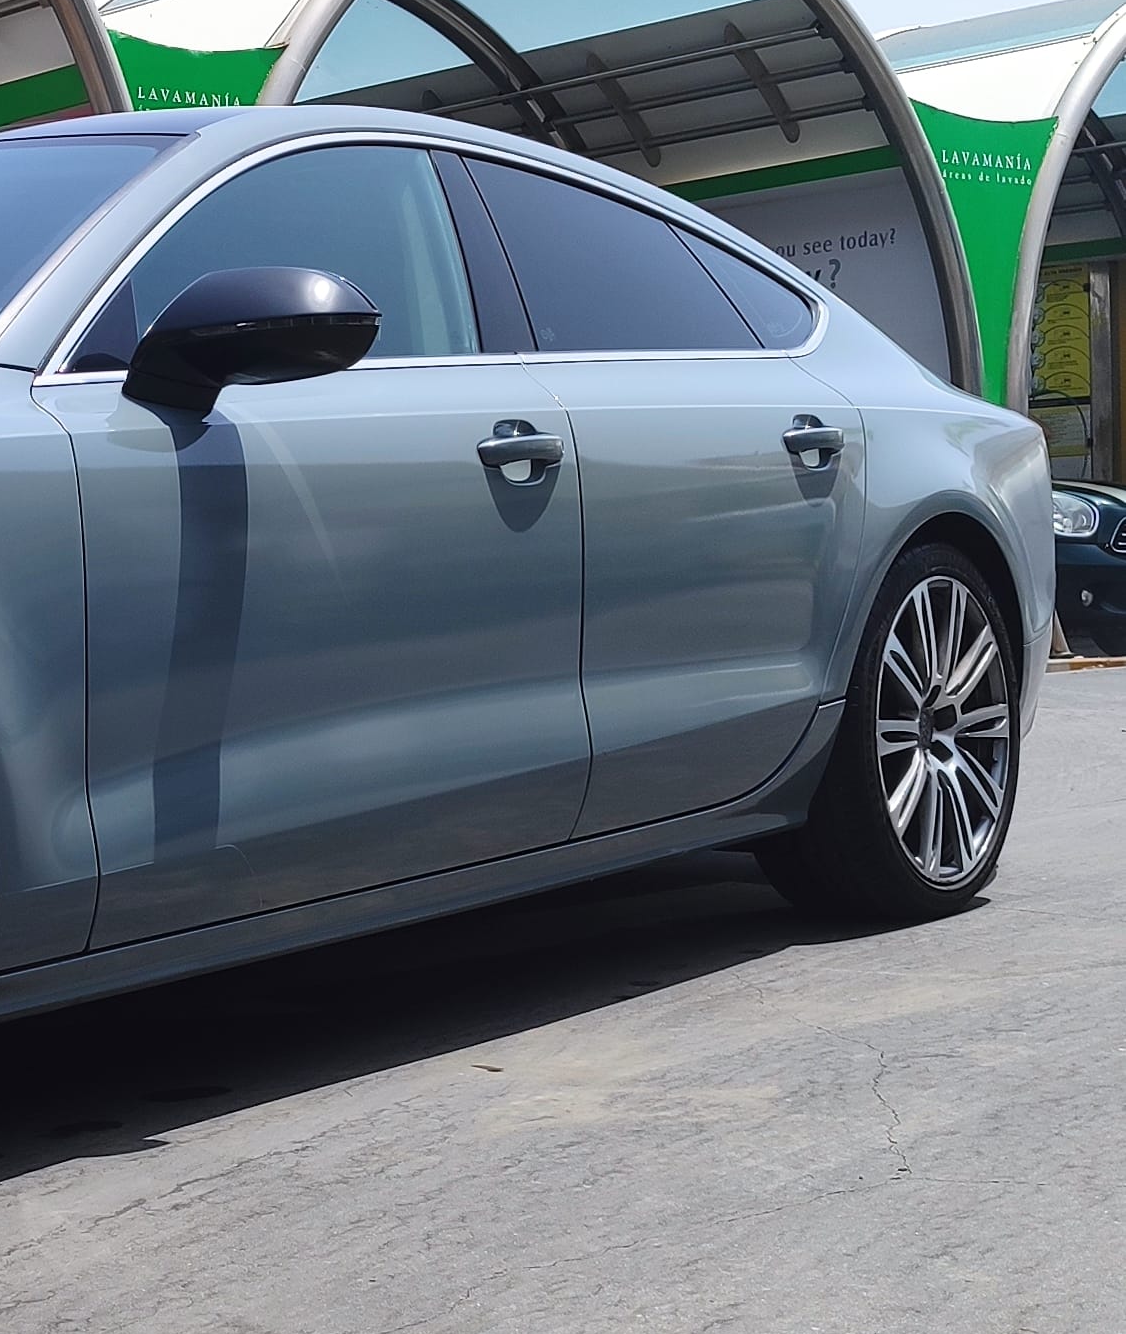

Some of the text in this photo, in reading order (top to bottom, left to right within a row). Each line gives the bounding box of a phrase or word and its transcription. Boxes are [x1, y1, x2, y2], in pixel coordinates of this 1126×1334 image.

[137, 86, 241, 107] LAVAMANÍA
[942, 149, 1031, 171] LAVAMANÍA
[979, 171, 990, 182] de
[996, 172, 1032, 185] lavado
[803, 239, 833, 255] see
[840, 228, 896, 250] today?
